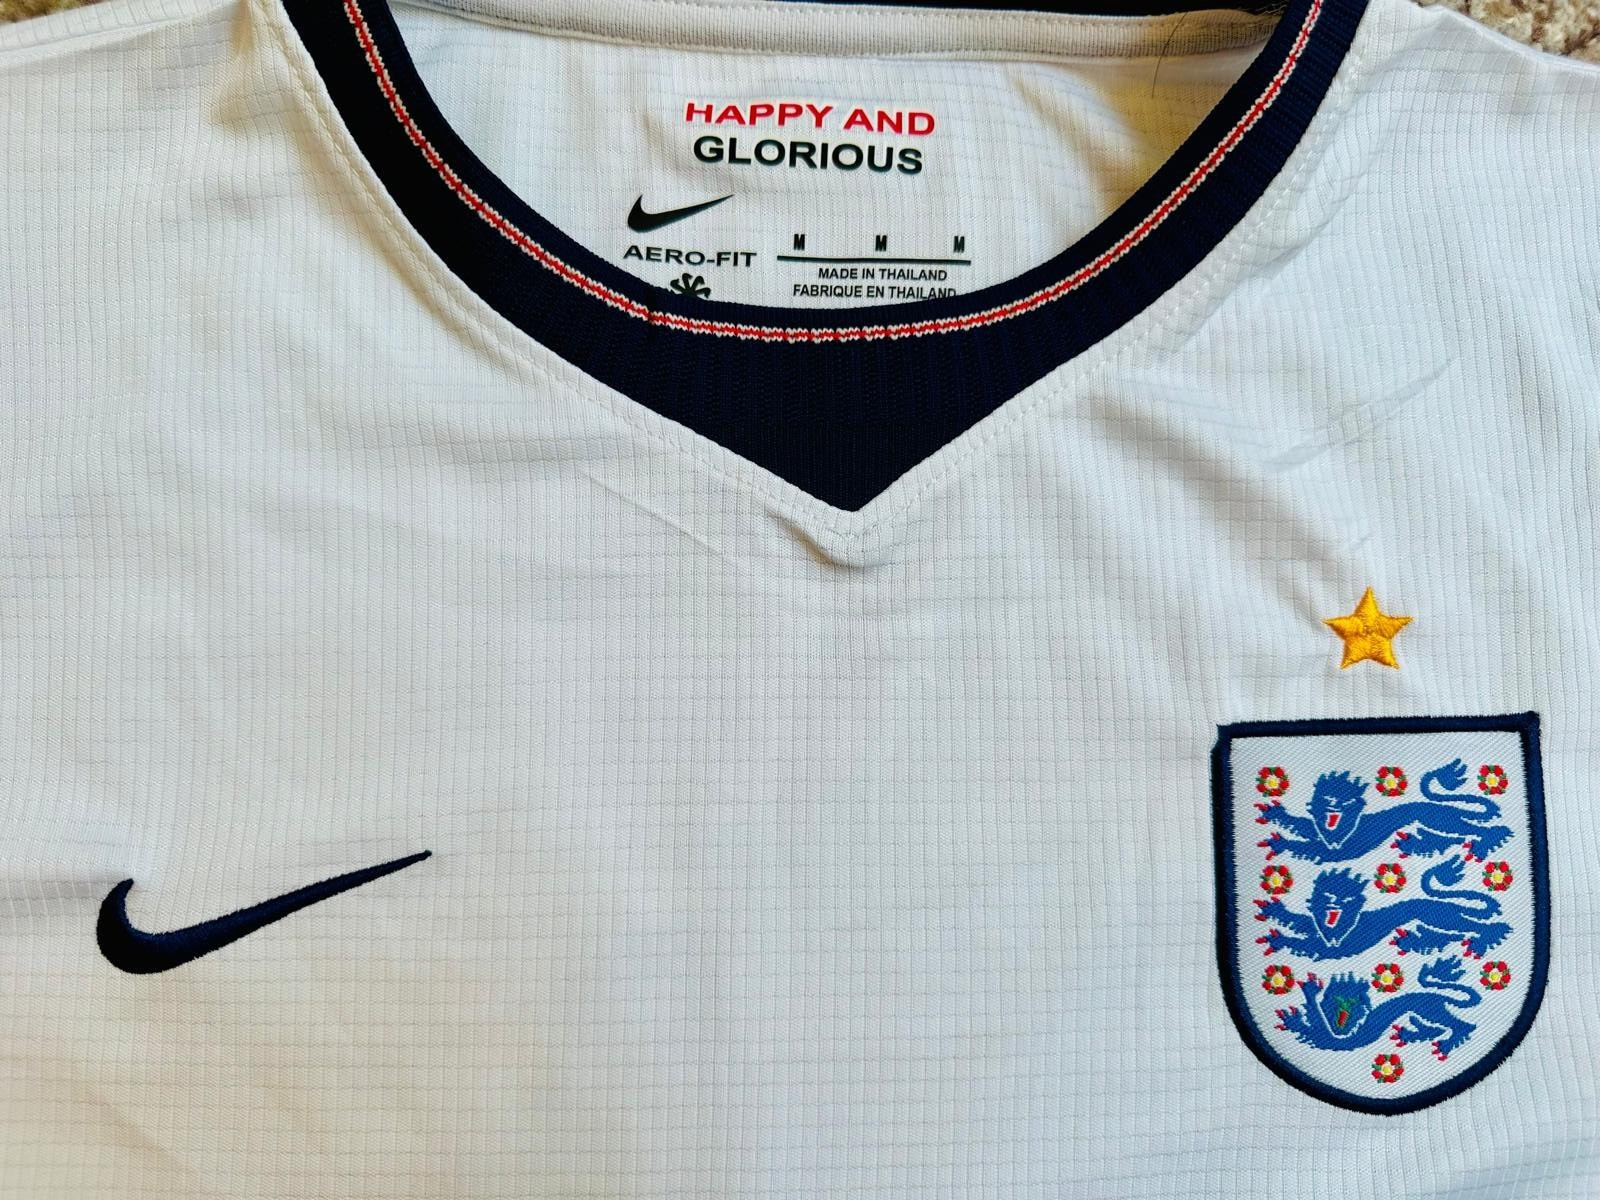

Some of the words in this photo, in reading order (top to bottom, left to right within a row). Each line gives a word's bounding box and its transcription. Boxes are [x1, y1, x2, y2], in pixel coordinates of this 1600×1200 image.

[685, 102, 833, 128] HAPPY
[843, 108, 935, 136] AND
[693, 135, 923, 175] GLORIOUS
[794, 233, 805, 250] M
[875, 235, 887, 252] M
[953, 236, 965, 253] M
[623, 244, 757, 268] AERO-FIT
[818, 267, 858, 279] MADE
[861, 268, 873, 279] IN
[878, 268, 948, 281] THAILAND
[792, 284, 862, 297] FABRIQUE
[866, 285, 885, 297] EN
